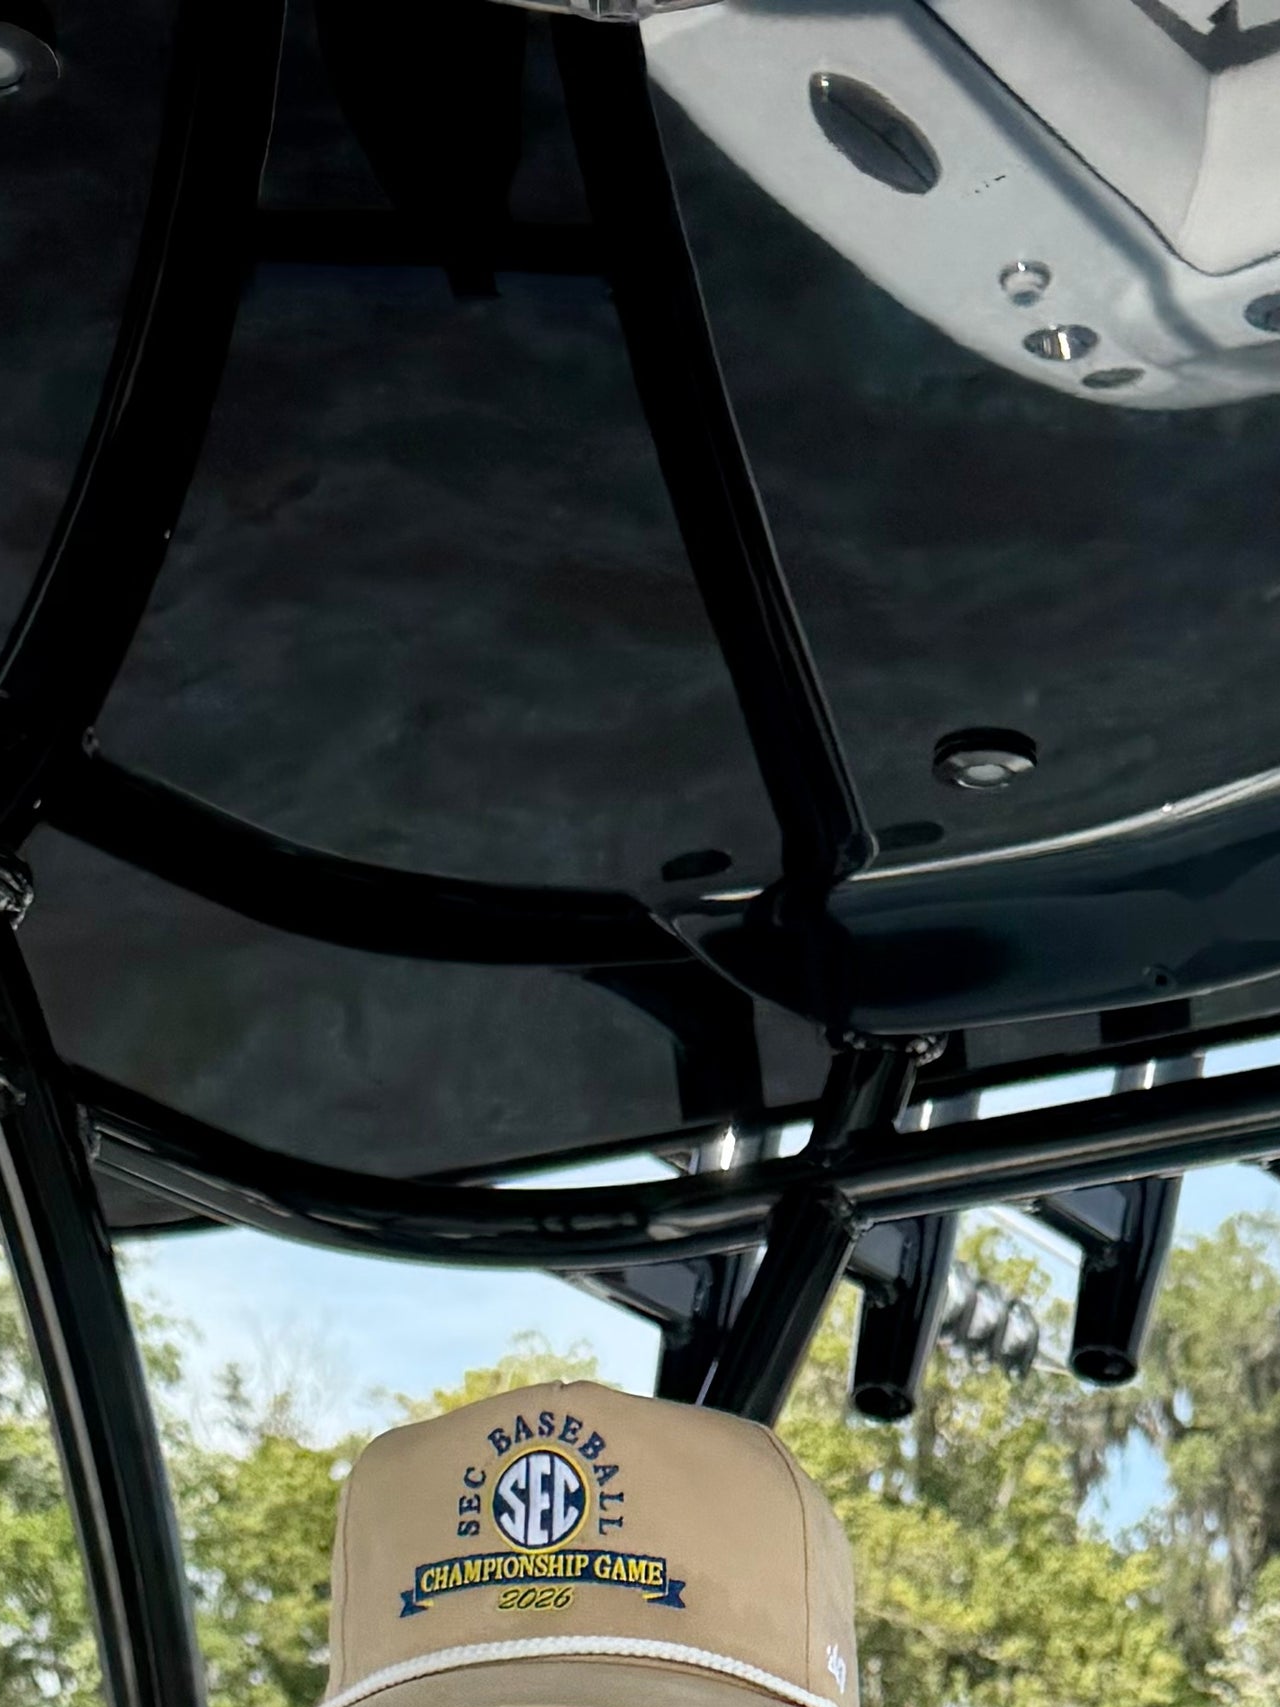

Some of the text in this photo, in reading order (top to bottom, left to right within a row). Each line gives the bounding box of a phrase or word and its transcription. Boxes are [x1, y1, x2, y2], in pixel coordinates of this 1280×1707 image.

[456, 1410, 625, 1537] SEC BASEBALL
[497, 1453, 581, 1546] SEC
[420, 1552, 665, 1593] CHAMPIONSHIP GAME
[497, 1585, 573, 1611] 2026
